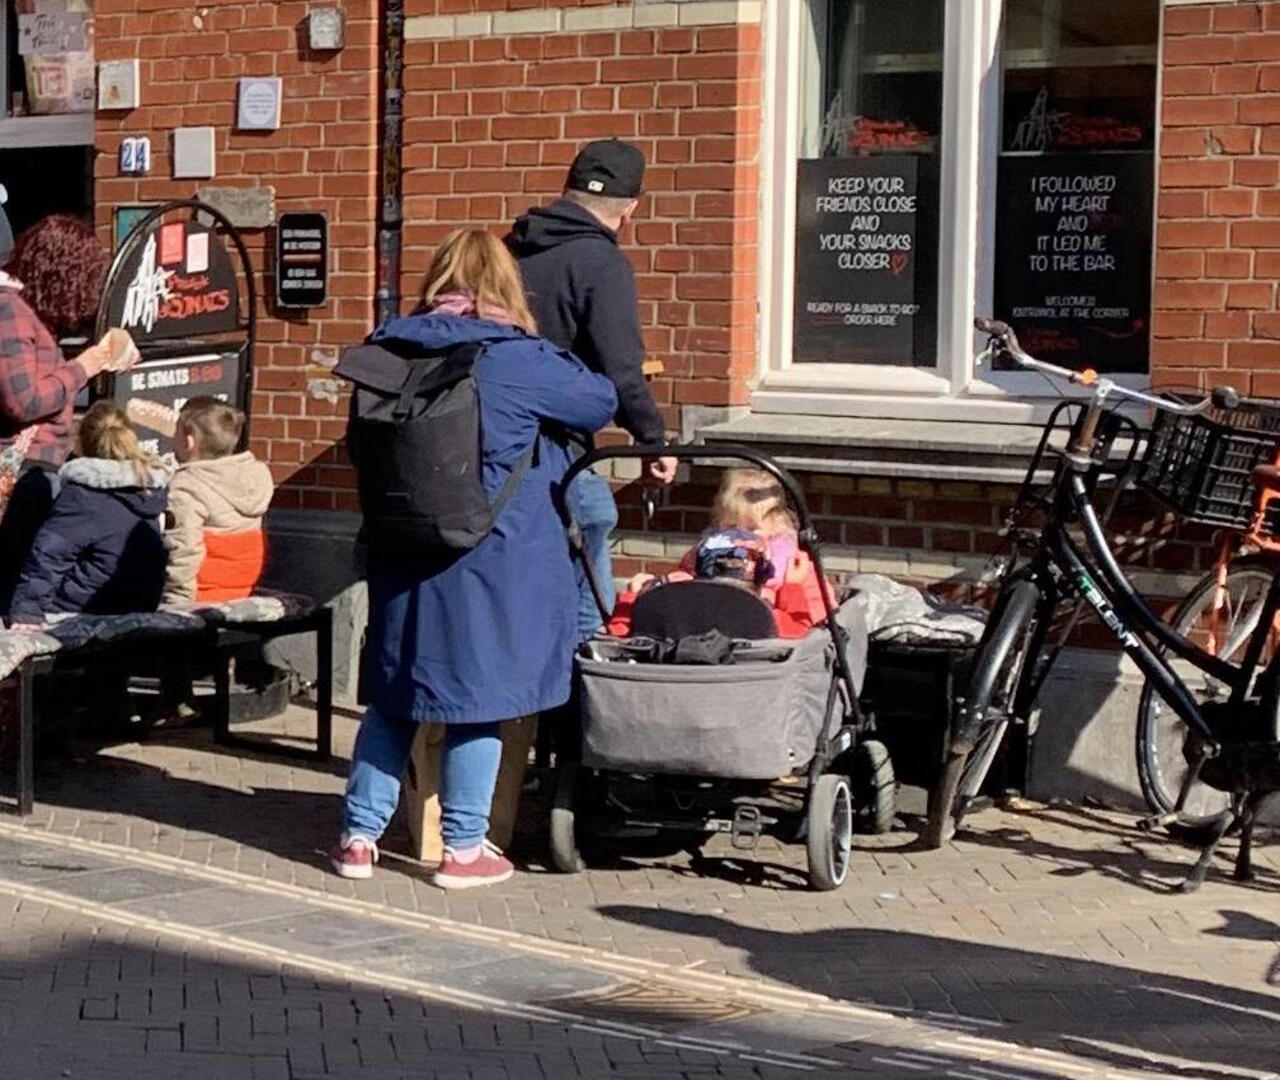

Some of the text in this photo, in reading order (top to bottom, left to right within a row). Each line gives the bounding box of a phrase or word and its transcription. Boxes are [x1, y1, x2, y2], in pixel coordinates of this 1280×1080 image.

[122, 141, 146, 170] 24
[828, 177, 905, 194] KEEP YOUR
[1031, 176, 1116, 193] I FOLLOWED
[816, 196, 917, 213] FRIENDS CLOSE
[1035, 195, 1110, 212] MY HEART
[850, 215, 881, 232] AND
[1057, 216, 1089, 232] AND
[819, 234, 912, 251] YOUR SNACKS
[1037, 235, 1106, 251] IT LED ME
[837, 253, 890, 270] CLOSER
[1029, 255, 1116, 271] TO THE BAR
[835, 302, 852, 313] FOR
[889, 304, 900, 314] TO
[874, 315, 897, 326] HERE
